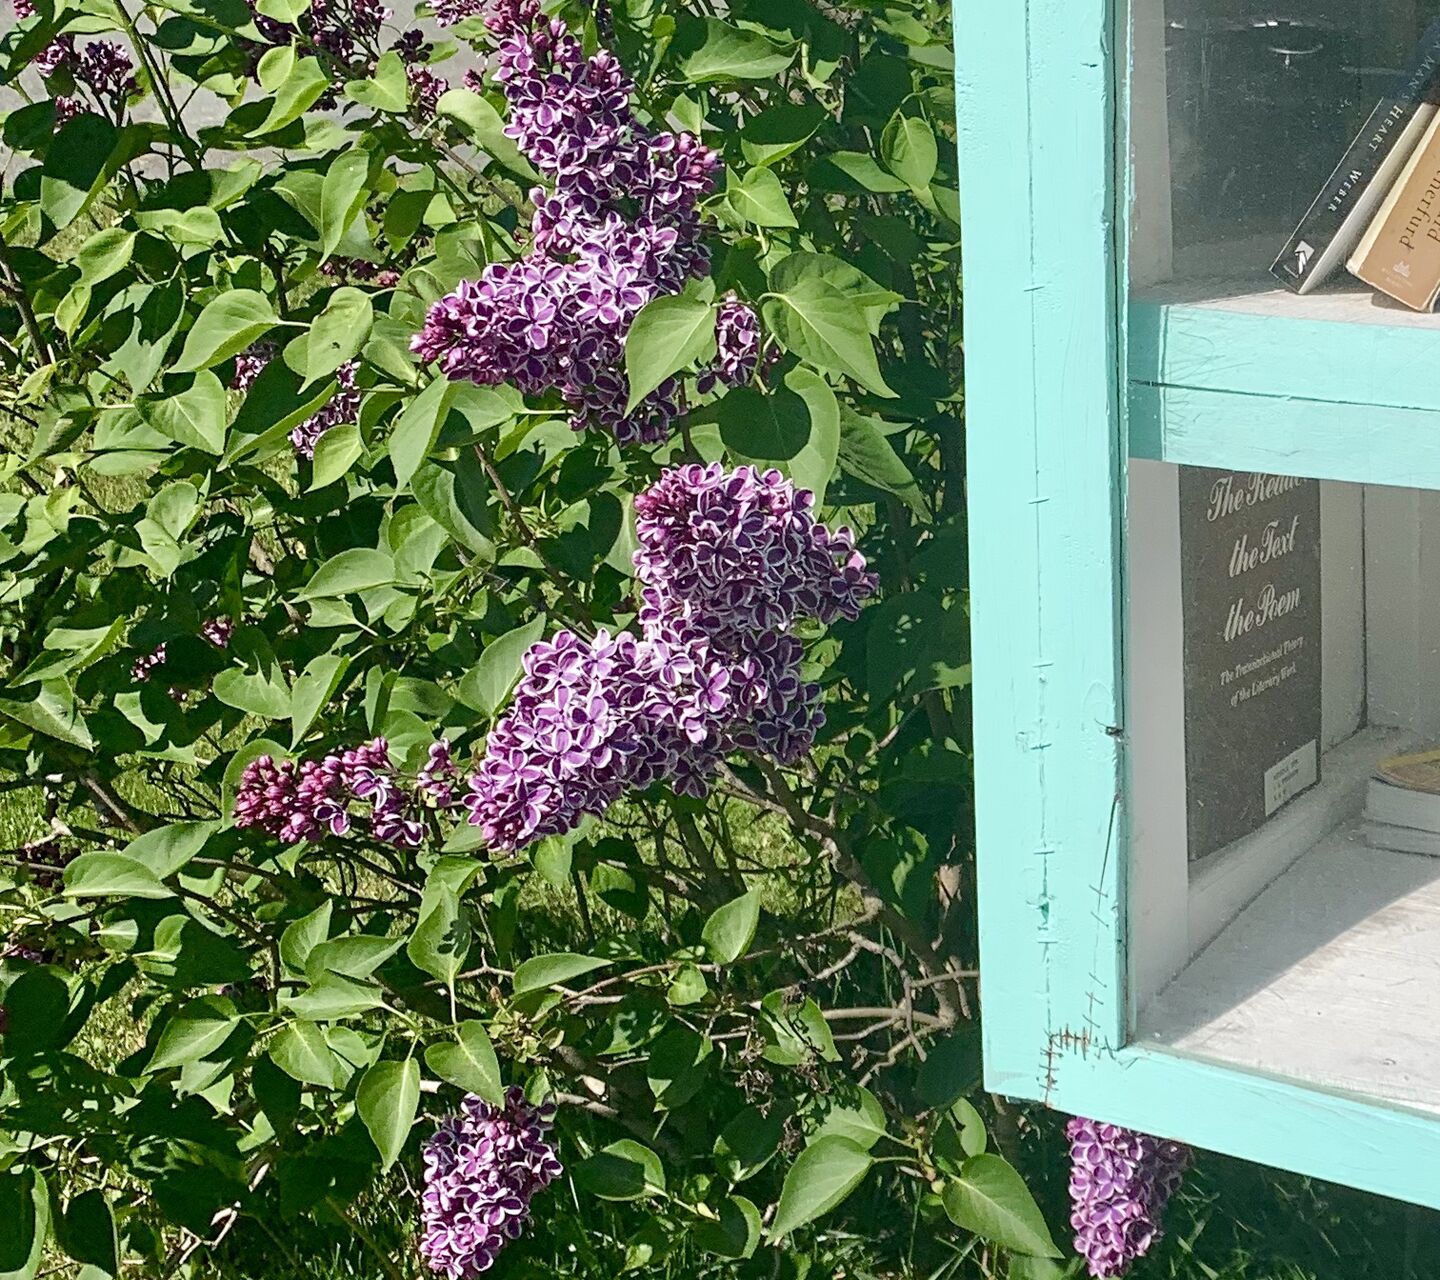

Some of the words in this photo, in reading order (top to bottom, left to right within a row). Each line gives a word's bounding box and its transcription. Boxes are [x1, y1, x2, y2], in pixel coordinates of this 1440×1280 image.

[1364, 102, 1406, 154] HEART
[1324, 166, 1363, 215] WEBER
[1206, 476, 1244, 521] The
[1229, 534, 1259, 578] the
[1259, 515, 1300, 564] Text
[1224, 598, 1255, 642] the
[1255, 584, 1300, 627] Poem
